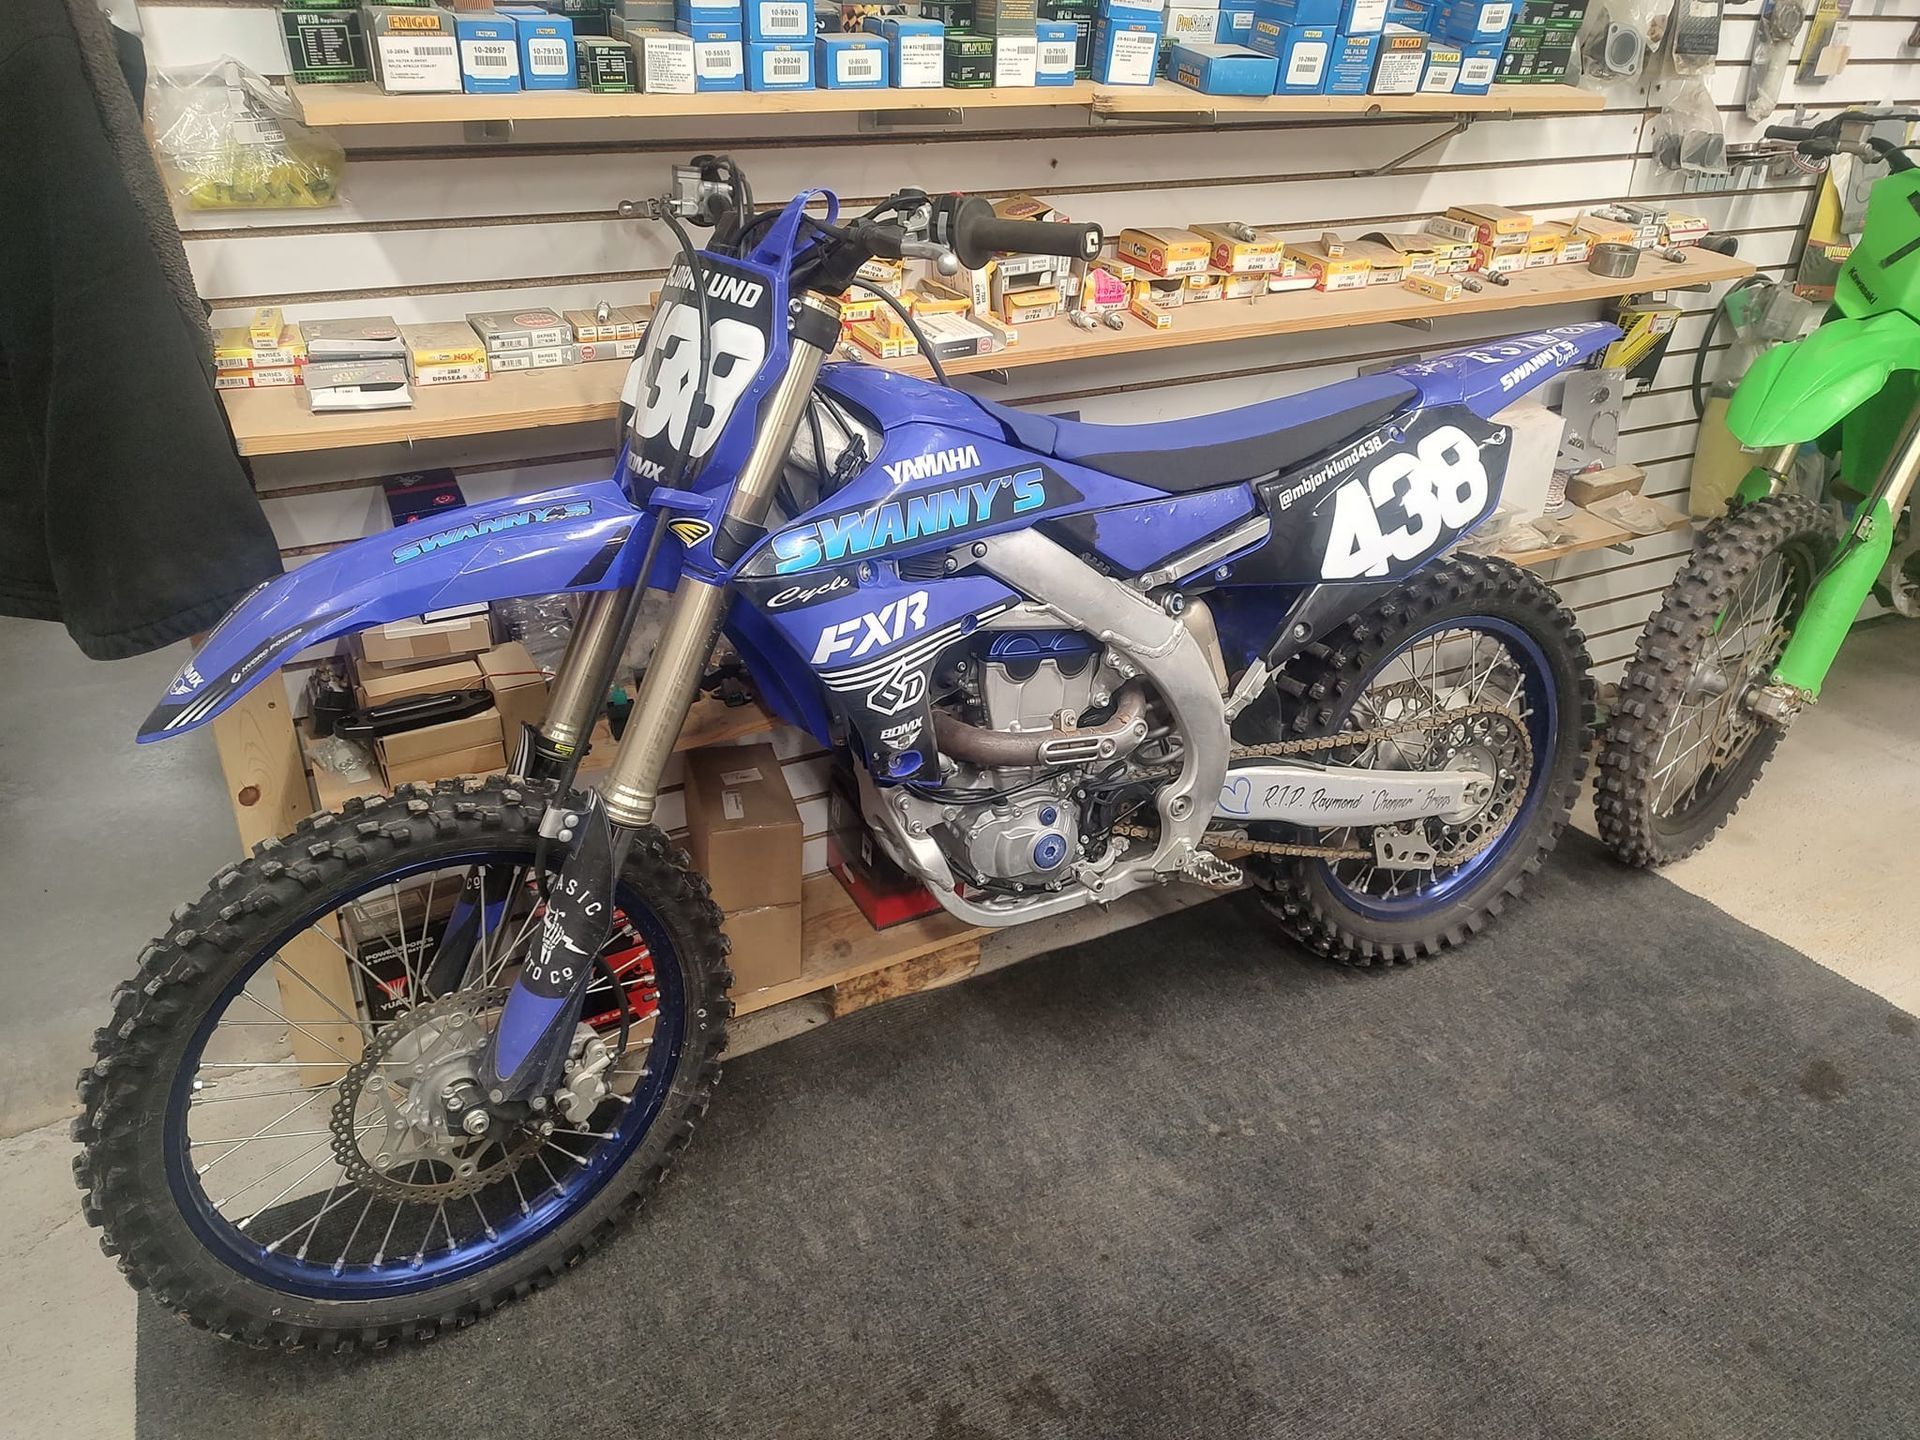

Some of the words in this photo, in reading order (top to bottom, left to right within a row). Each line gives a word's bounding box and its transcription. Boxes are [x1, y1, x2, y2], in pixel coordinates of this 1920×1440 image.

[297, 14, 319, 24] HF138
[1175, 13, 1213, 31] ProSelect
[474, 46, 505, 54] 10-26957
[1847, 266, 1878, 305] Kawasaki
[453, 353, 475, 361] NGK
[1500, 340, 1574, 392] SWANNY'S
[882, 445, 981, 485] YAMAHA
[1279, 436, 1383, 510] @mbjorklund438
[771, 467, 1046, 575] SWANNY'S
[1321, 425, 1488, 580] 438
[393, 500, 592, 565] SWANNY'S
[766, 574, 850, 609] Cycle
[810, 590, 929, 665] FXR
[242, 648, 269, 673] HYDRO
[270, 628, 302, 651] POWER
[1309, 787, 1363, 811] Raymond
